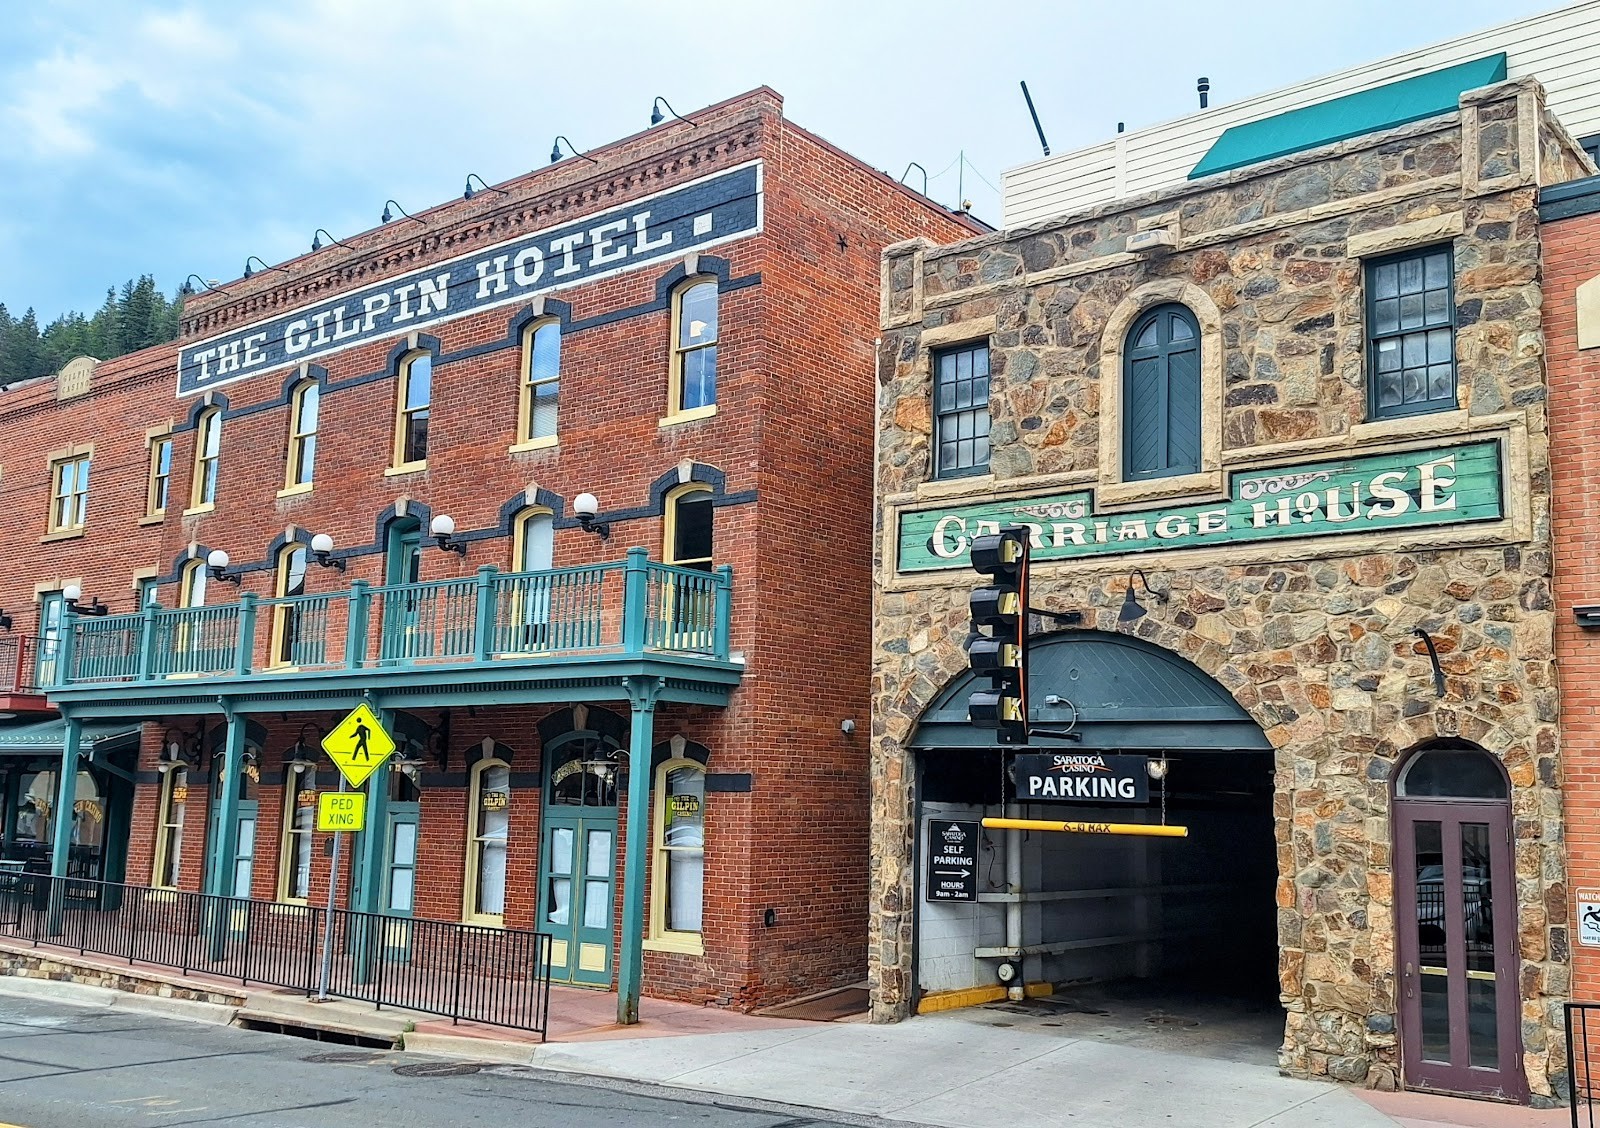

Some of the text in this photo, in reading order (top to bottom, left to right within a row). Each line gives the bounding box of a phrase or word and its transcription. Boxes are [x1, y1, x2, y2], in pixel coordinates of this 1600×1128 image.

[192, 332, 267, 382] THE
[284, 272, 450, 355] GILPIN
[1250, 453, 1457, 529] HOUSE
[1053, 755, 1105, 766] SARATOGA
[1062, 765, 1095, 774] CASINO
[1029, 776, 1136, 799] PARKING
[331, 798, 354, 810] PED
[483, 797, 506, 806] GILPIN
[671, 801, 699, 811] GILPIN
[328, 813, 354, 825] XING
[1088, 823, 1111, 833] MAX
[943, 845, 965, 854] SELF
[933, 856, 973, 866] PARKING
[940, 881, 965, 889] HOURS
[935, 890, 951, 898] 9am
